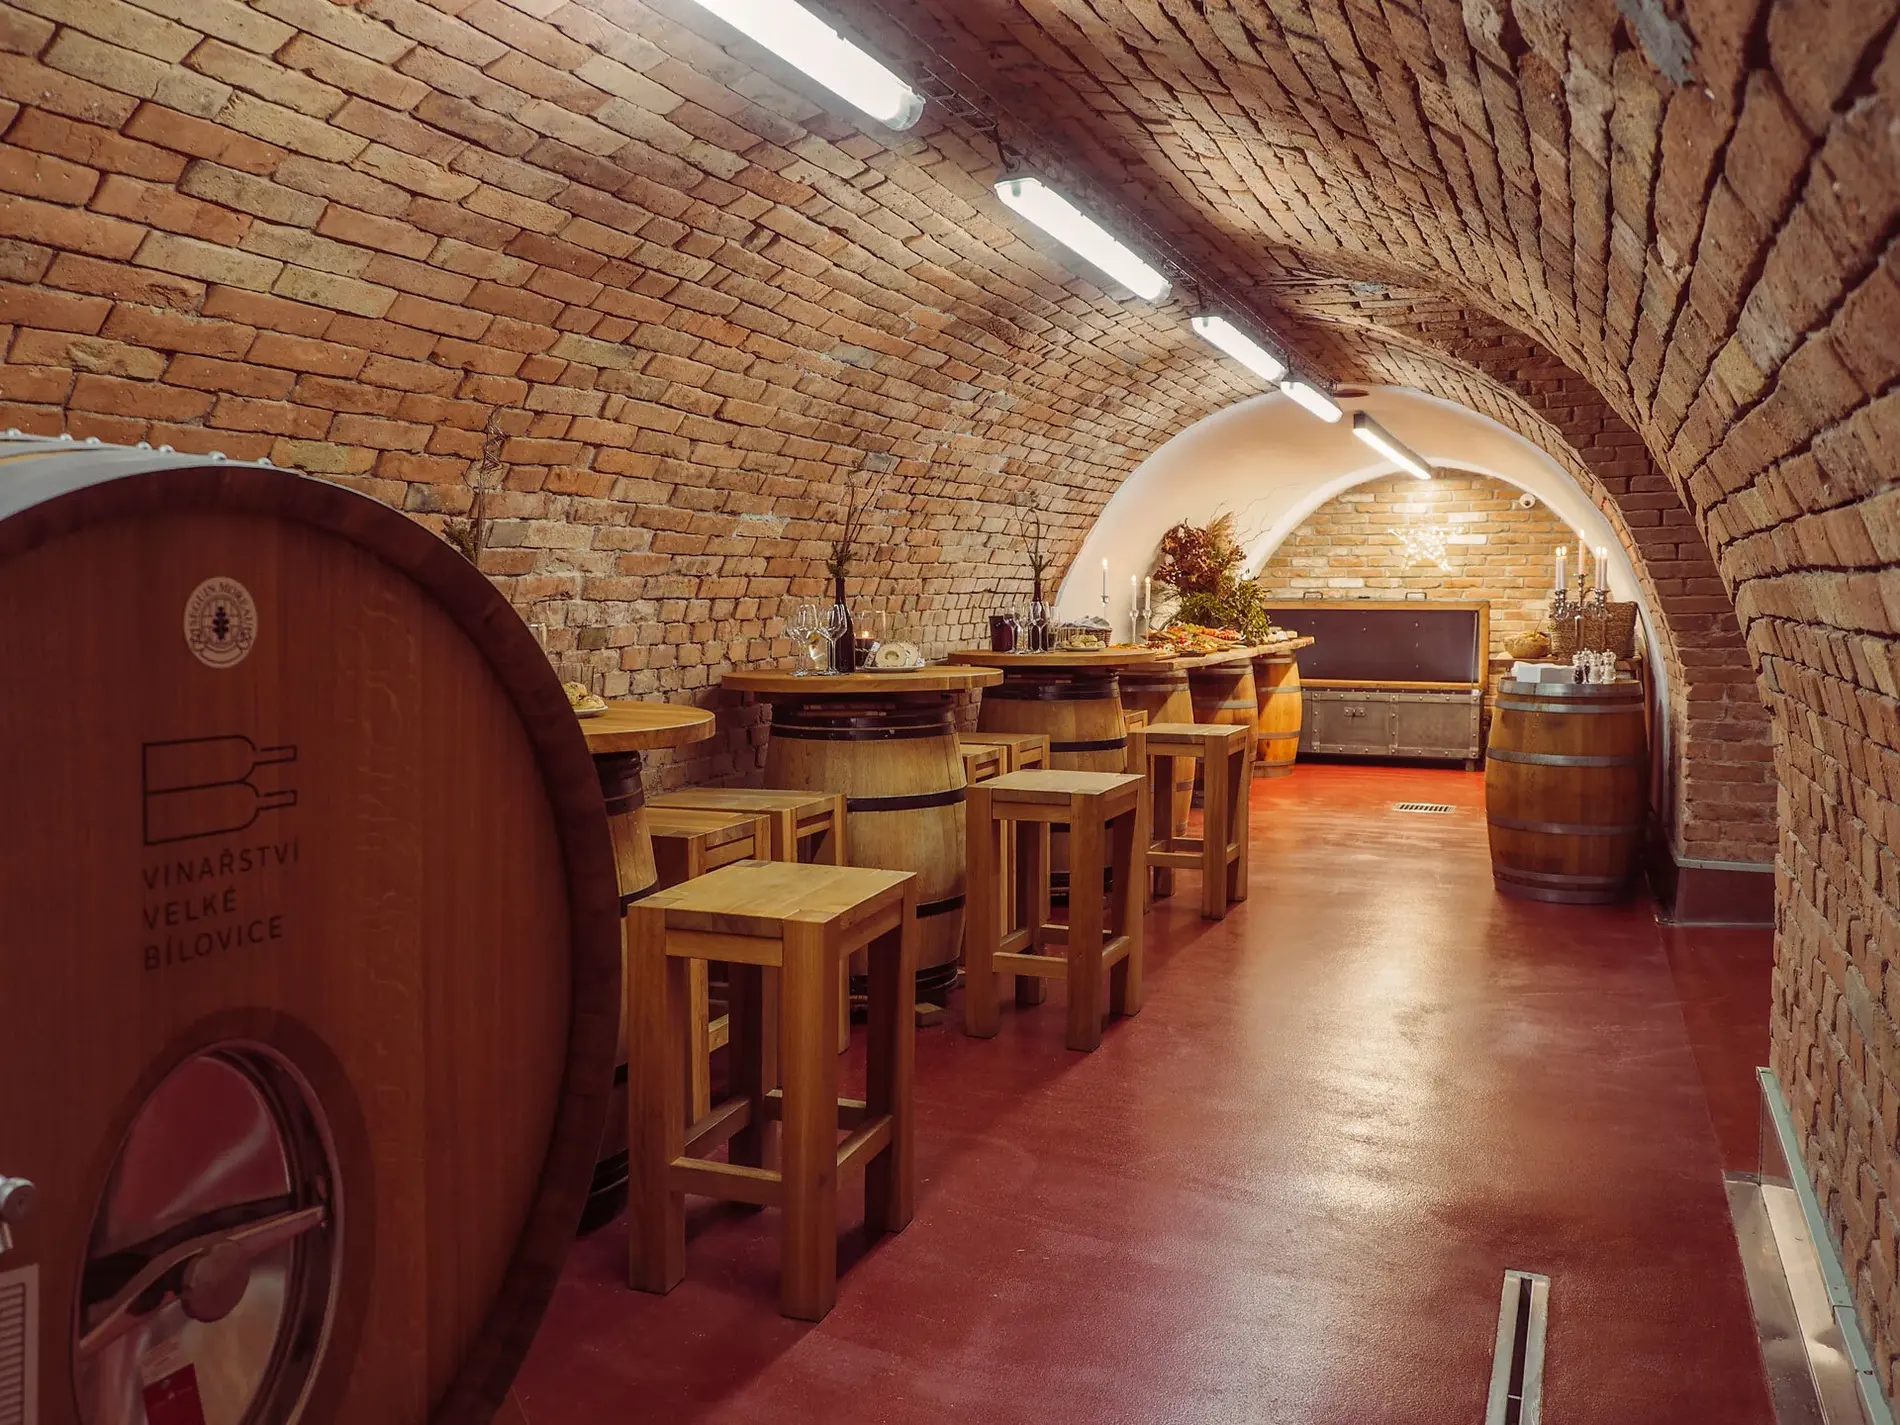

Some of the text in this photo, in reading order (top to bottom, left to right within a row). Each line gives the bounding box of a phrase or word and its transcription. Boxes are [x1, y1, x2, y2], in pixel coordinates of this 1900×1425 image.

[142, 836, 299, 889] VINAŘSTVÍ
[143, 885, 237, 931] VELKÉ
[144, 915, 284, 970] BÍLOVICE
